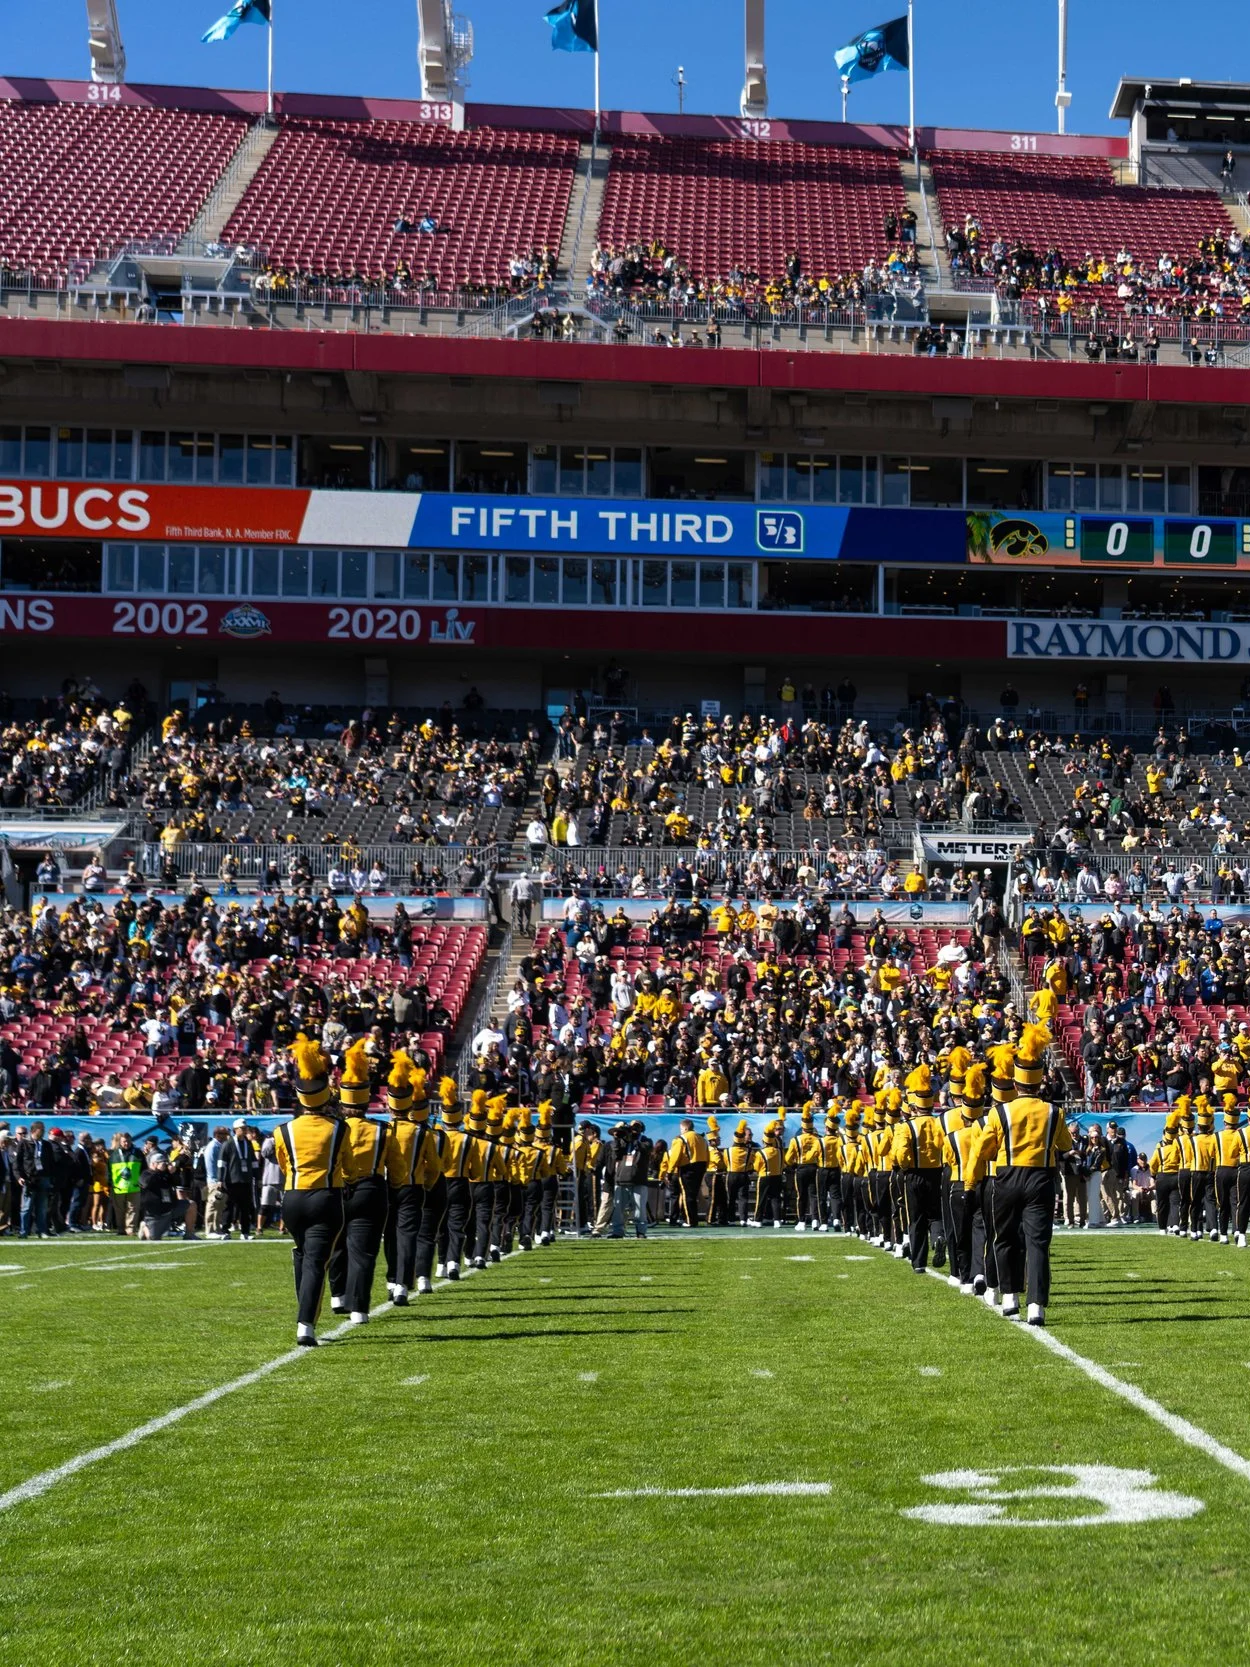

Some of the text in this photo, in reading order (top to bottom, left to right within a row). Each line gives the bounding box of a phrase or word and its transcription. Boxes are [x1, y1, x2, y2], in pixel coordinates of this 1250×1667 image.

[87, 84, 122, 101] 314
[420, 103, 452, 120] 313
[740, 121, 771, 138] 312
[1010, 135, 1037, 151] 311
[0, 485, 151, 532] BUCS
[451, 507, 734, 543] FIFTH THIRD
[165, 525, 182, 536] Fifth
[184, 526, 202, 537] Third
[203, 527, 224, 538] Bank,
[244, 529, 274, 540] Member
[1106, 522, 1129, 556] 0
[1189, 525, 1212, 558] 0
[112, 601, 209, 635] 2002
[327, 606, 422, 641] 2020
[1011, 621, 1242, 661] RAYMOND
